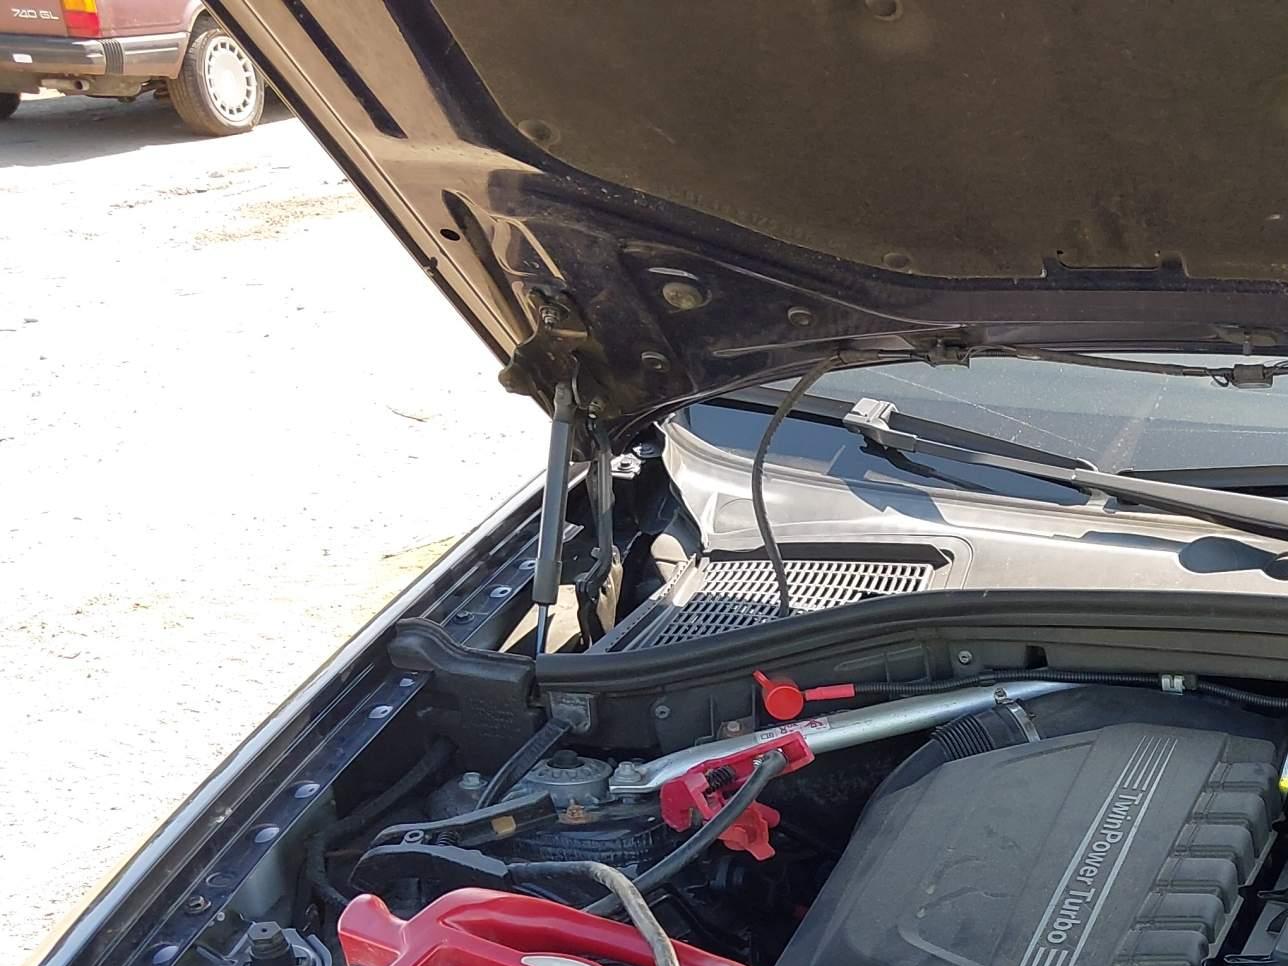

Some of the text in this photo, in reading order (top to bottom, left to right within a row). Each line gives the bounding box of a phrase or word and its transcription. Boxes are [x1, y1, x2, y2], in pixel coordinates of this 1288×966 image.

[11, 8, 60, 20] 740 GL
[1047, 790, 1144, 944] TwinPower Turbo
